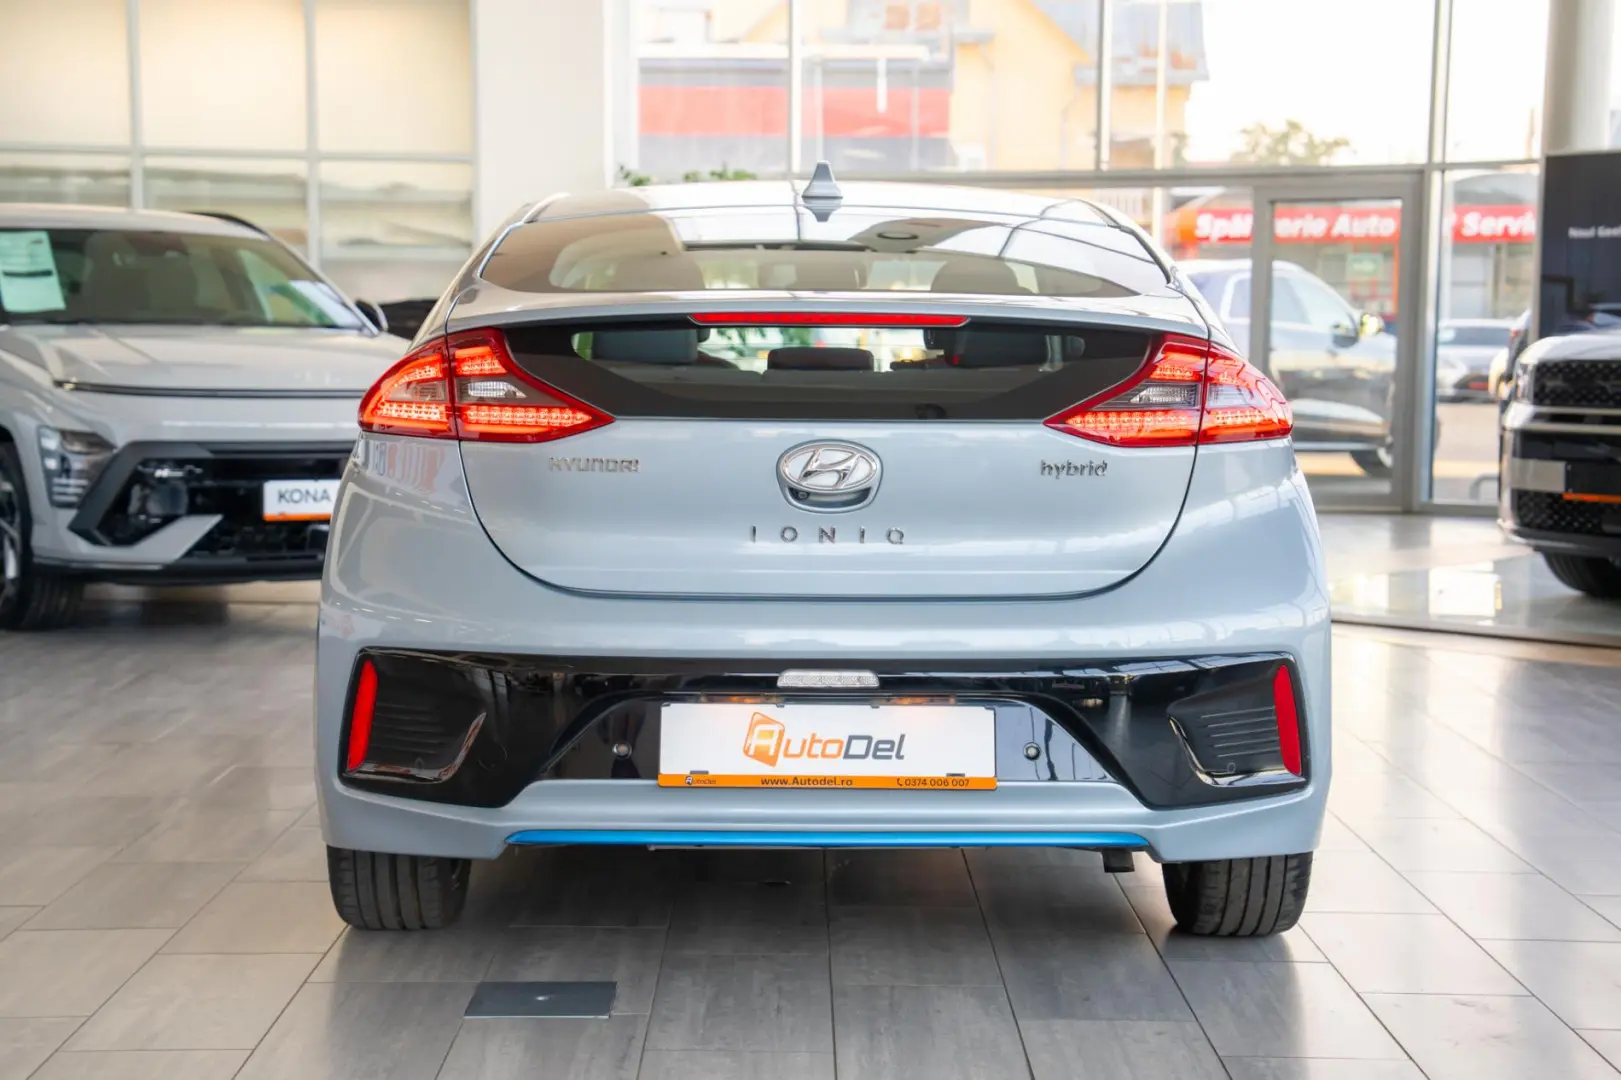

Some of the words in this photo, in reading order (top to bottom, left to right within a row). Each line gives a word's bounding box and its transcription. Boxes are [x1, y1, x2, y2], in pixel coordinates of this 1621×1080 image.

[1331, 213, 1396, 238] Auto
[1461, 211, 1536, 237] Servi
[548, 457, 640, 473] HYUNDAI
[1040, 459, 1108, 480] hybrid
[277, 487, 332, 504] KONA
[750, 525, 905, 545] IONIQ
[744, 715, 906, 764] AutoDel
[760, 775, 853, 787] www.Autodel.ro
[904, 777, 927, 787] 0374
[929, 777, 949, 787] 006
[951, 778, 970, 788] 007
